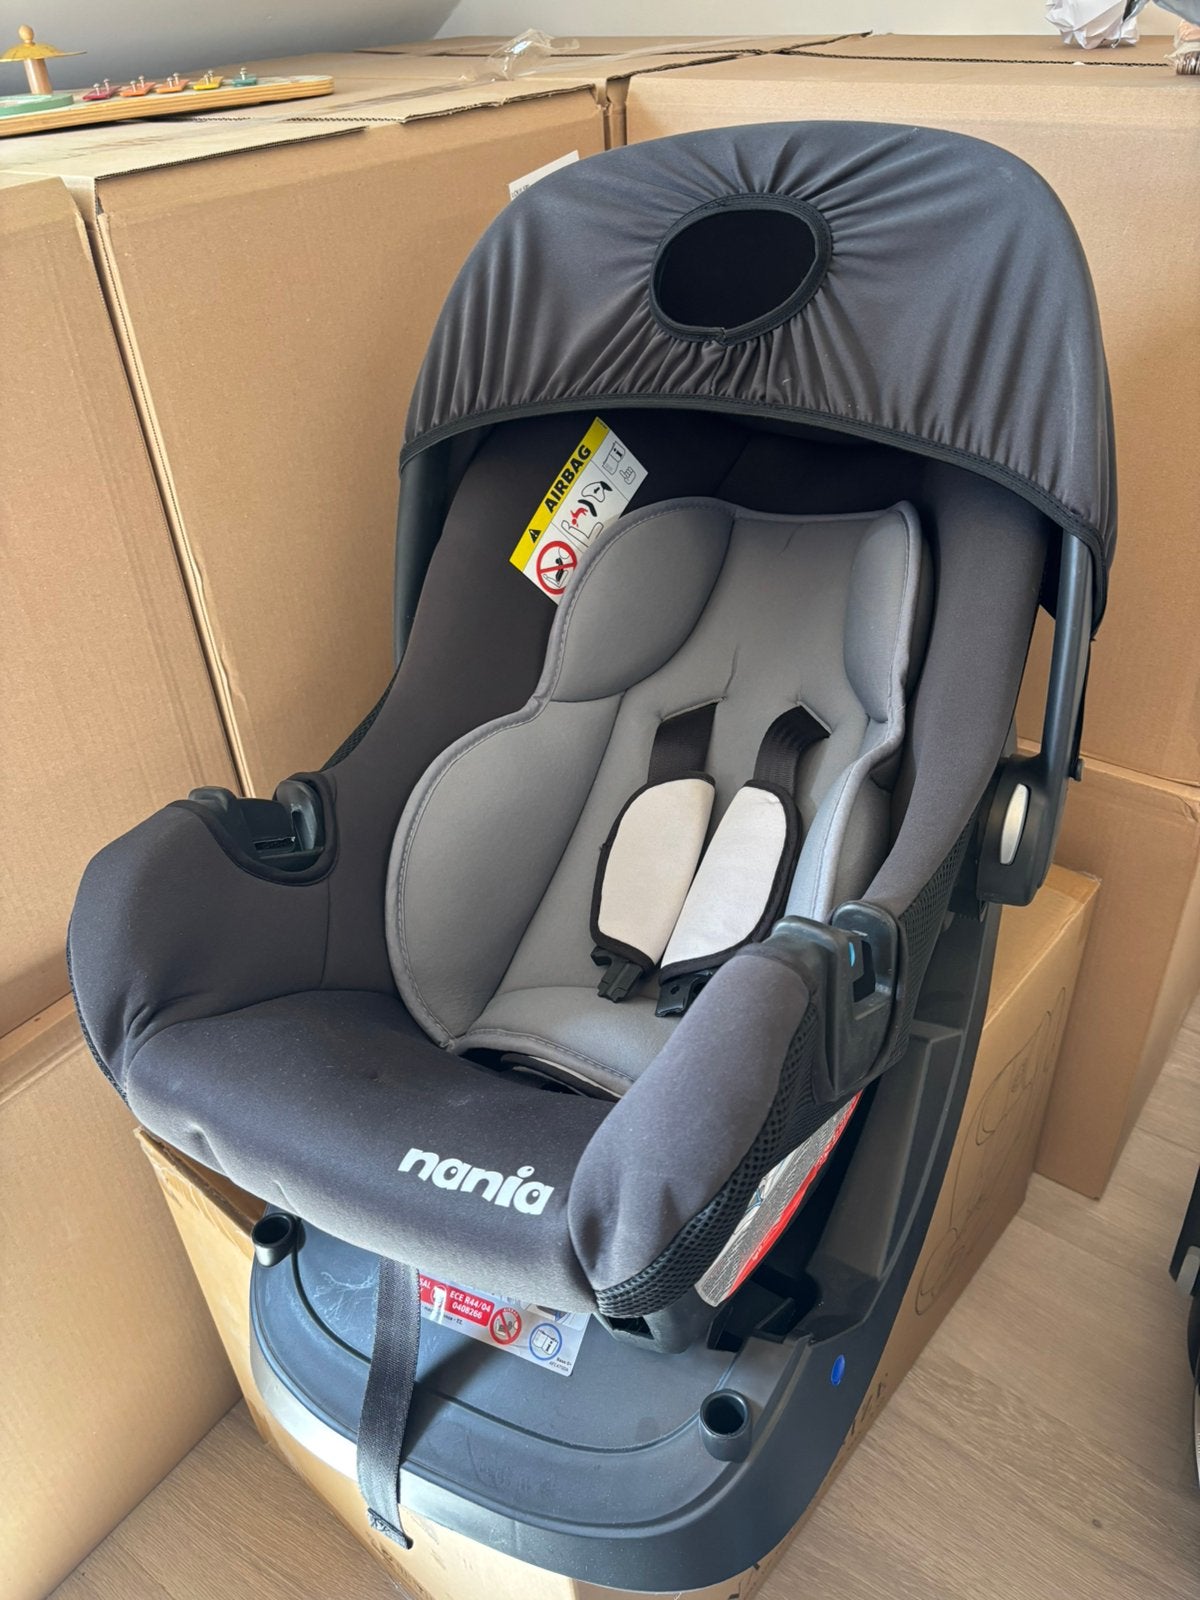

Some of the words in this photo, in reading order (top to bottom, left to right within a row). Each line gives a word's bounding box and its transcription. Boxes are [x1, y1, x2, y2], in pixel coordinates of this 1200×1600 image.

[544, 444, 592, 514] AIRBAG
[397, 1147, 555, 1216] nania
[449, 1290, 465, 1302] ECE
[464, 1295, 491, 1312] R44/04
